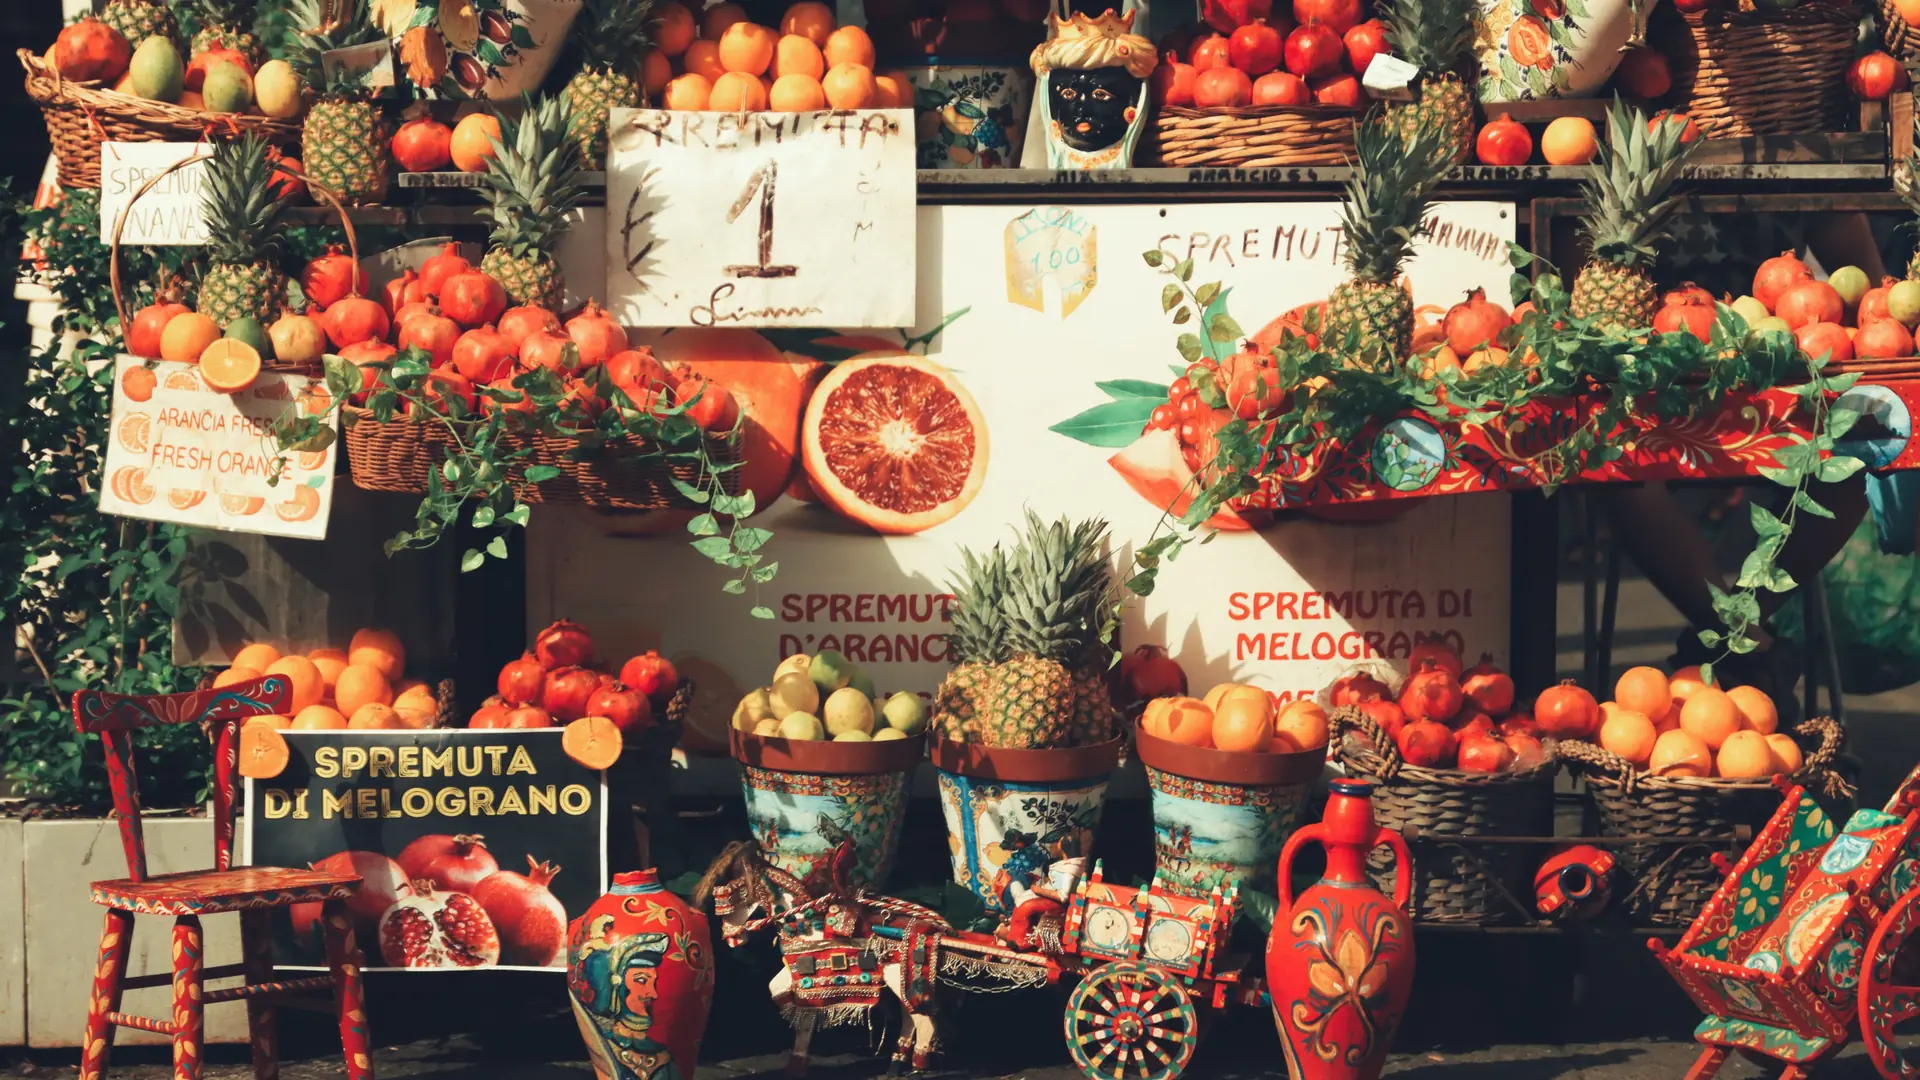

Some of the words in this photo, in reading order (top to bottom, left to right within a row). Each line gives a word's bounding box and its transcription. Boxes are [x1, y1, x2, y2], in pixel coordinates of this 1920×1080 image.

[109, 166, 202, 195] SPREMUT
[1158, 224, 1345, 275] SPREMUT
[157, 407, 225, 432] ARANCIA
[151, 444, 212, 470] FRESH
[218, 451, 294, 480] ORANGE
[781, 593, 956, 623] SPREMUT
[1228, 588, 1426, 620] SPREMUTA
[1438, 588, 1473, 618] DI
[315, 745, 537, 778] SPREMUTA
[265, 788, 309, 819] DI
[322, 784, 592, 819] MELOGRANO
